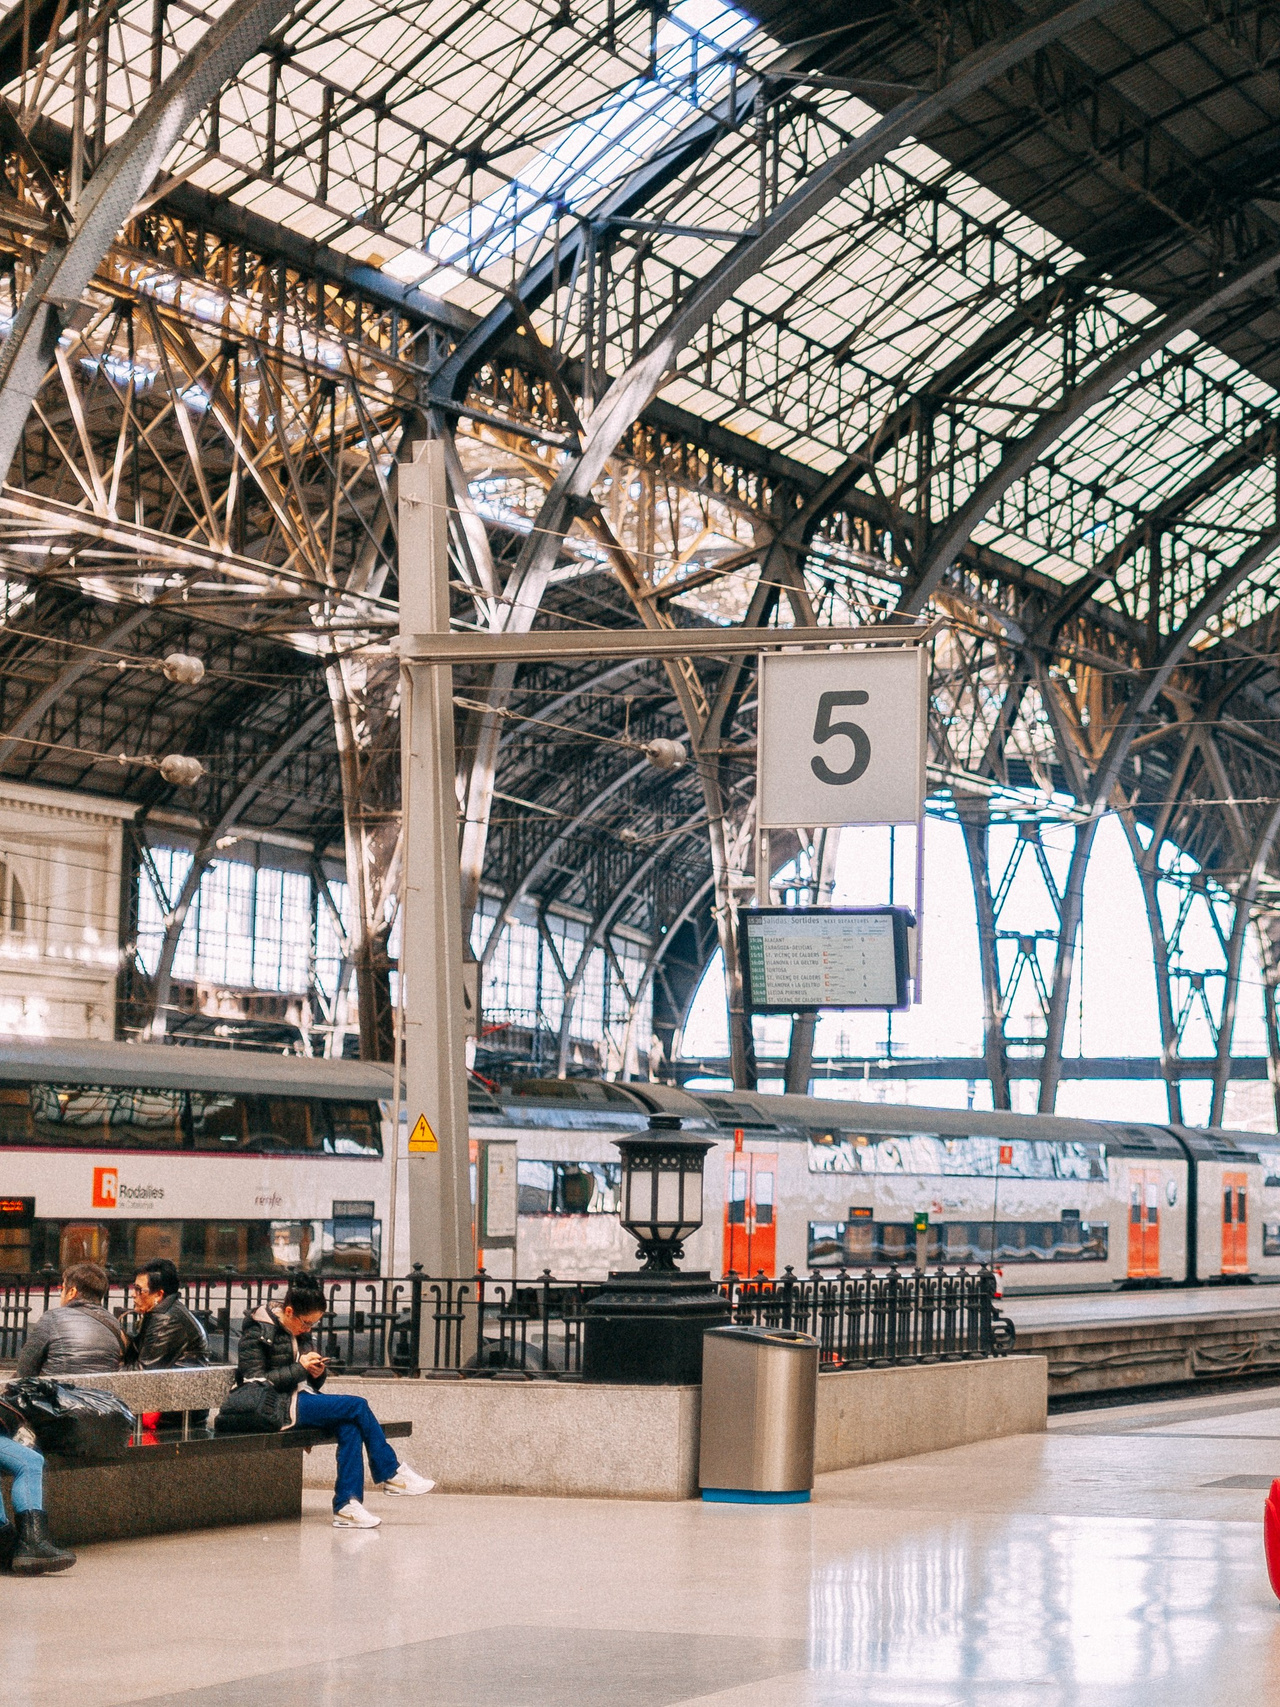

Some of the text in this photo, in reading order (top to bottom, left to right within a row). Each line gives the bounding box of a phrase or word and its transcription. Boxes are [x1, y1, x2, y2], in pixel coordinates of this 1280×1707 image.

[811, 690, 871, 785] 5
[763, 916, 788, 924] Salidas
[791, 916, 819, 924] Sortides
[102, 1173, 164, 1200] R Rodalies
[254, 1191, 282, 1210] renfe
